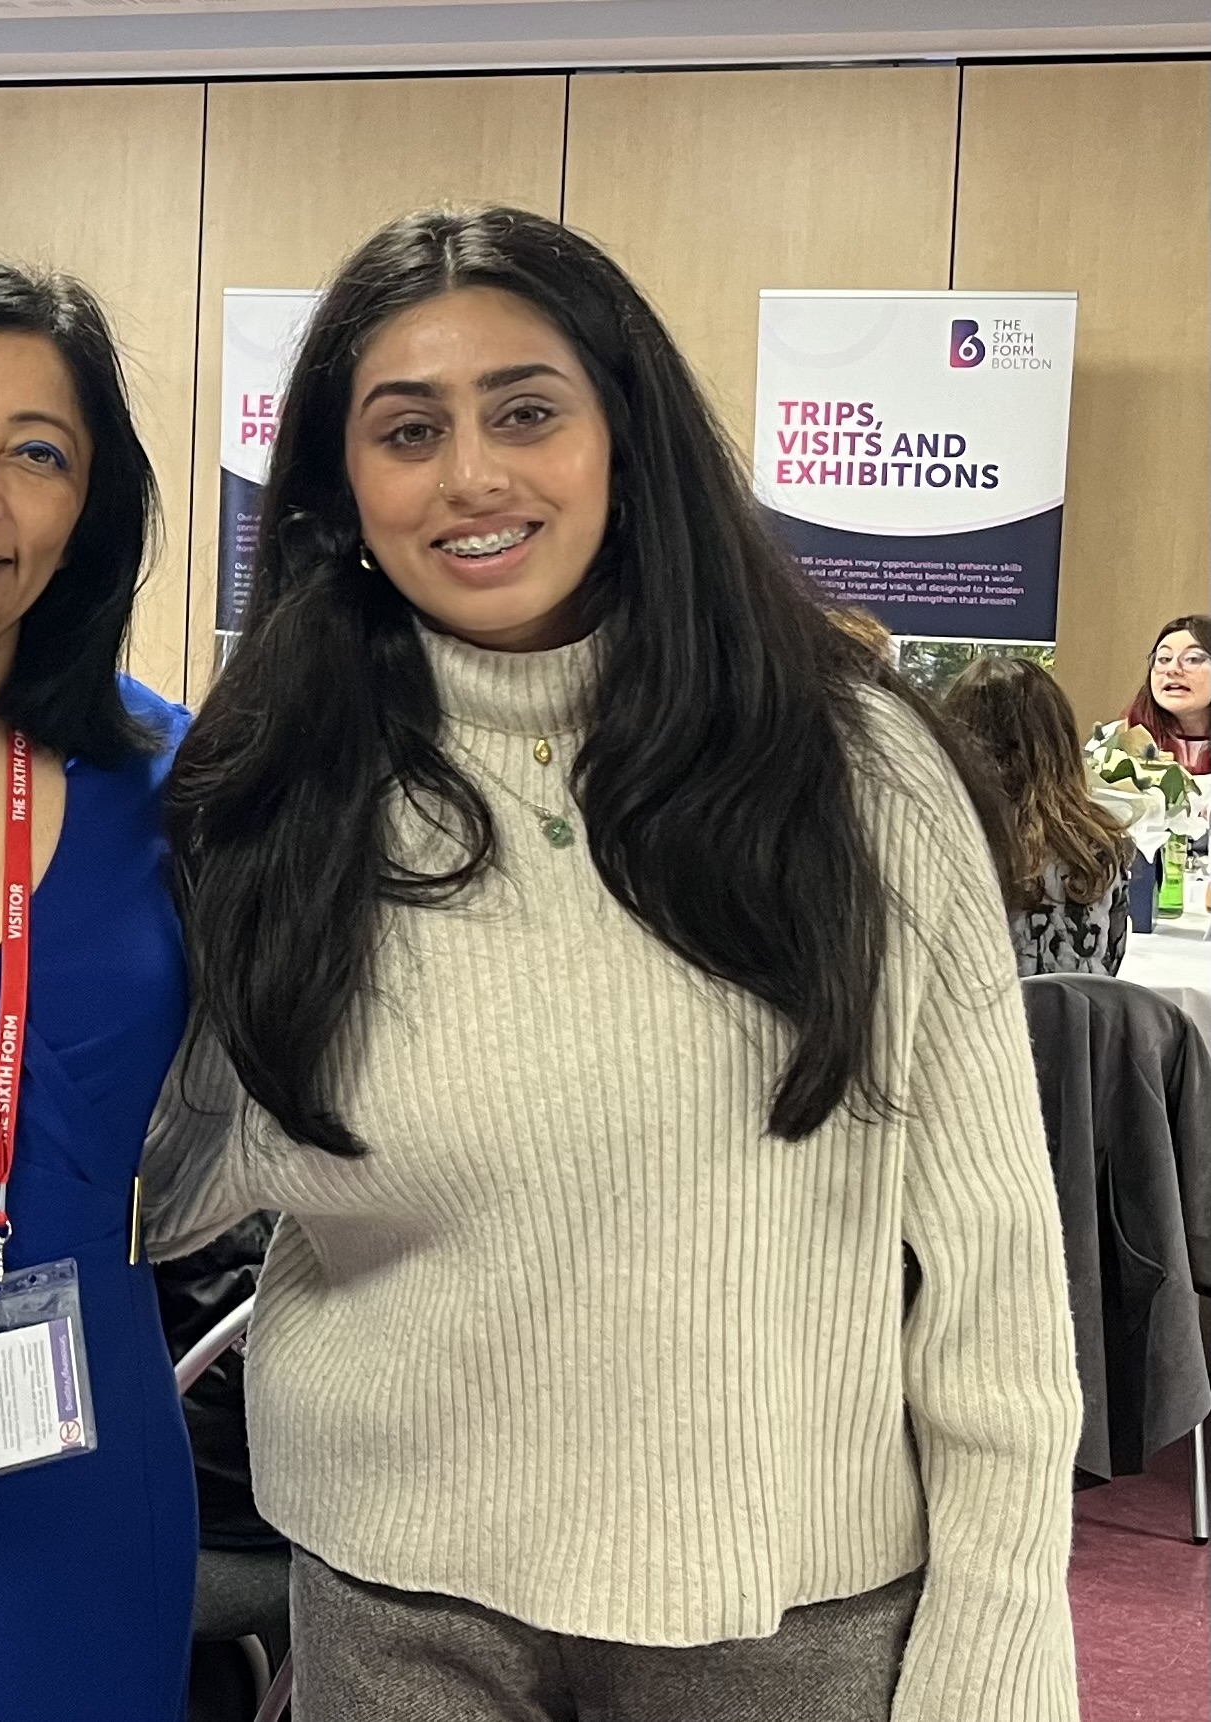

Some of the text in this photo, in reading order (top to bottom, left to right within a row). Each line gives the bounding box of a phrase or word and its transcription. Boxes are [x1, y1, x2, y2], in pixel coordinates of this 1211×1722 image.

[993, 319, 1022, 331] THE
[992, 332, 1034, 344] SIXTH
[992, 345, 1034, 356] FORM
[991, 358, 1052, 369] BOLTON
[778, 401, 883, 430] TRIPS,
[777, 430, 966, 458] VISITS AND
[776, 460, 999, 489] EXHIBITIONS
[815, 558, 853, 567] includes
[855, 560, 880, 569] many
[882, 560, 943, 571] opportunities
[946, 561, 955, 570] to
[958, 562, 998, 571] enhance
[1000, 563, 1022, 572] skills
[809, 569, 826, 577] and
[828, 569, 841, 577] off
[883, 571, 923, 580] Students
[925, 572, 957, 581] benefit
[960, 573, 981, 581] from
[992, 574, 1014, 583] wide
[870, 582, 887, 590] and
[916, 583, 928, 591] all
[929, 584, 971, 594] designed
[973, 585, 983, 593] to
[985, 585, 1024, 594] broaden
[888, 593, 905, 602] and
[907, 594, 957, 605] strengthen
[959, 595, 978, 604] that
[980, 596, 1017, 606] breadth
[13, 758, 27, 795] SIXTH
[11, 796, 27, 821] THE
[8, 883, 24, 940] VISITOR
[2, 1014, 18, 1063] FORM
